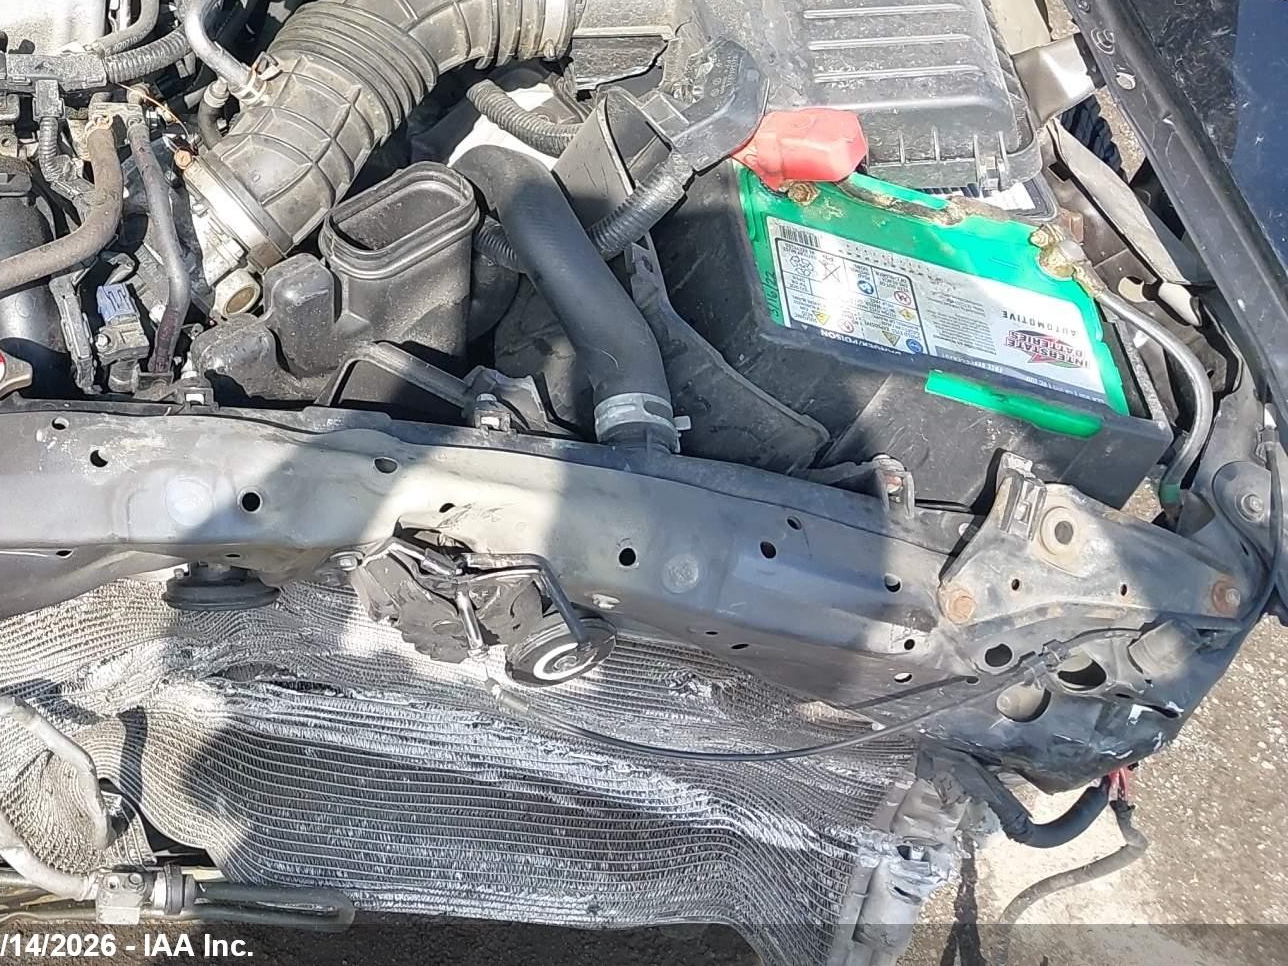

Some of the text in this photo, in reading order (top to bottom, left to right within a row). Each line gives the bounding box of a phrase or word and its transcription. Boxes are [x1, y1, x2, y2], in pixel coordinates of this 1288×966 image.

[1001, 310, 1079, 337] AUTOMOTIVE
[1005, 337, 1089, 368] INTERSTATE
[1009, 330, 1084, 358] BATTERIES
